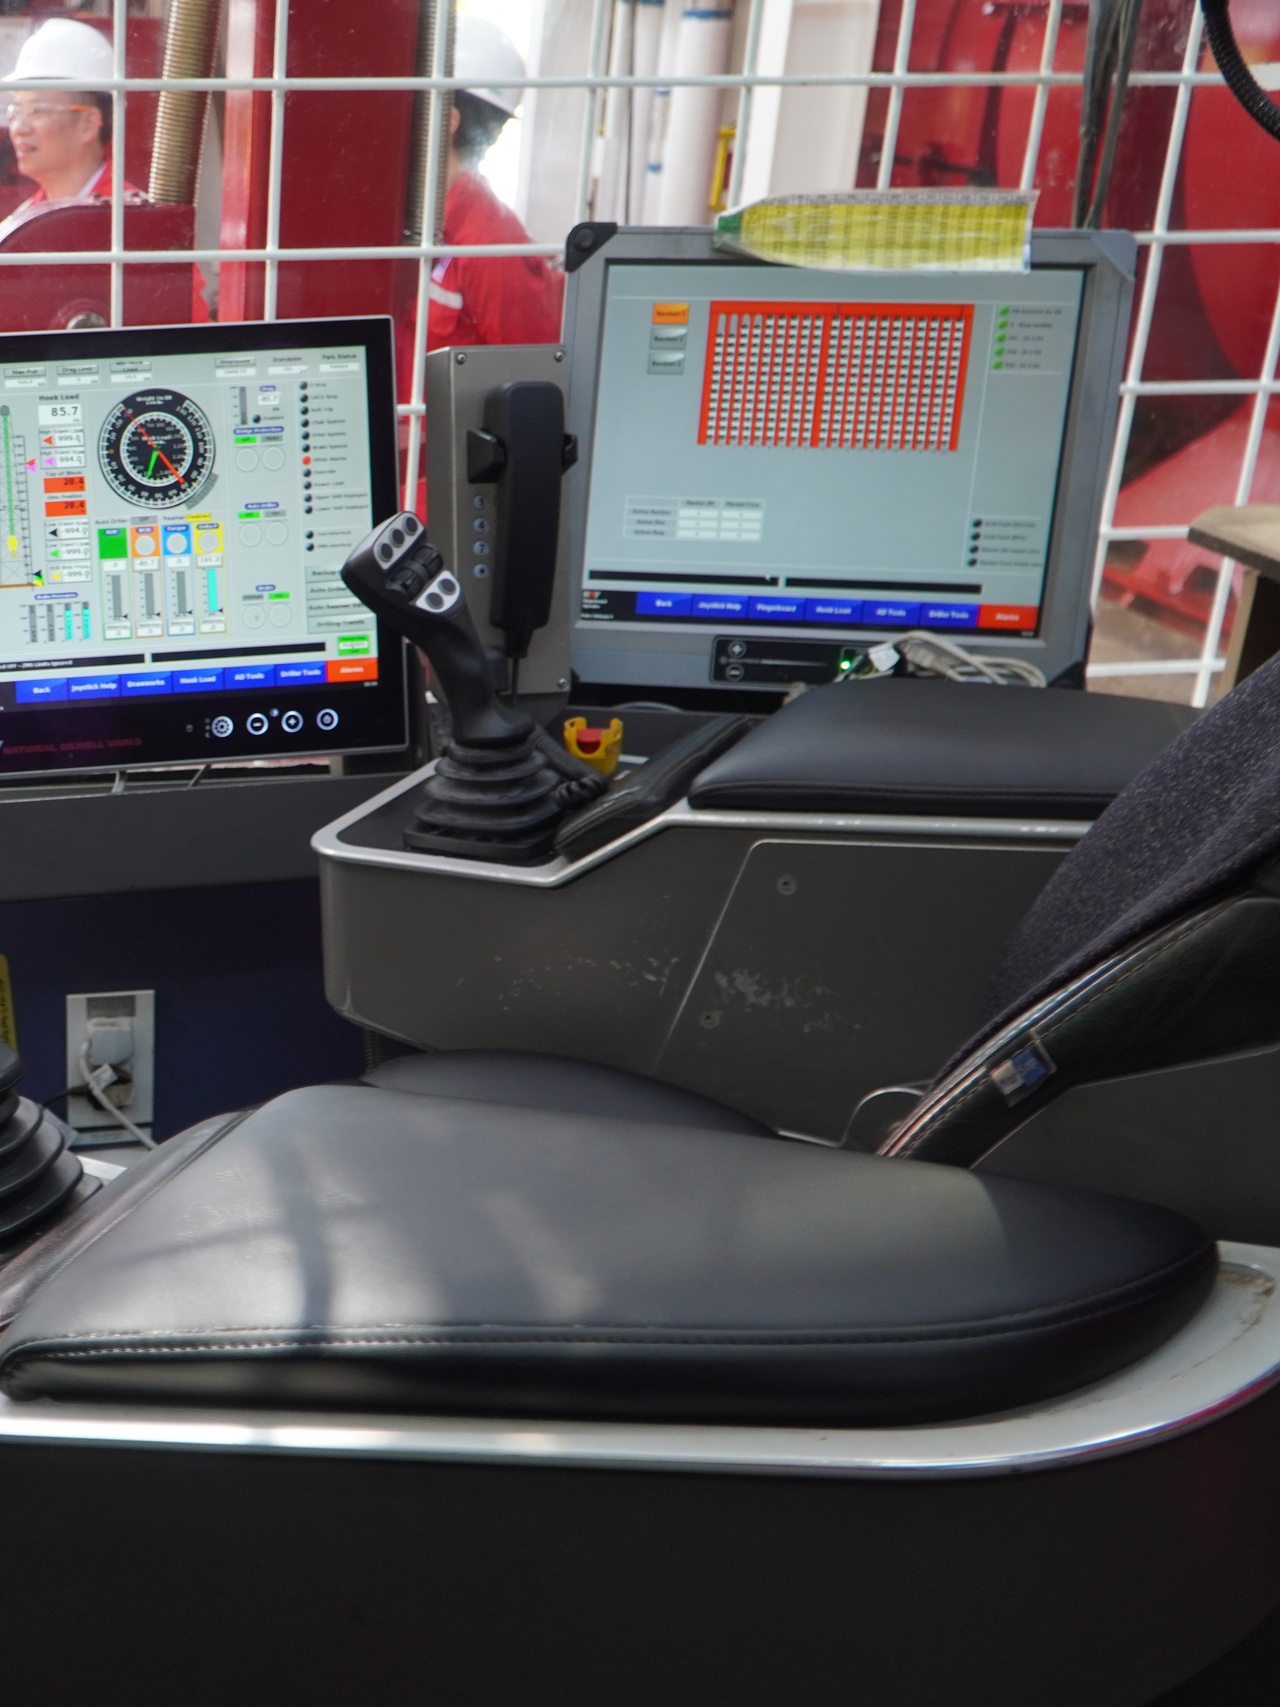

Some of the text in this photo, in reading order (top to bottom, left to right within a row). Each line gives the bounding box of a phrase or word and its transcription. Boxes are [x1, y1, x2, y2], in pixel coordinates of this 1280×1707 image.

[51, 406, 78, 417] 85.7
[64, 478, 84, 486] 28.4
[64, 501, 84, 509] 28.4
[280, 668, 321, 678] Driller Tools
[340, 666, 364, 674] Alarms
[180, 675, 216, 684] Hook Load
[247, 672, 265, 680] Tools
[71, 682, 118, 693] Joystick Help
[127, 679, 165, 688] Drawworks
[32, 686, 51, 694] Back
[3, 738, 143, 756] NATIONAL OILWELL VARCO
